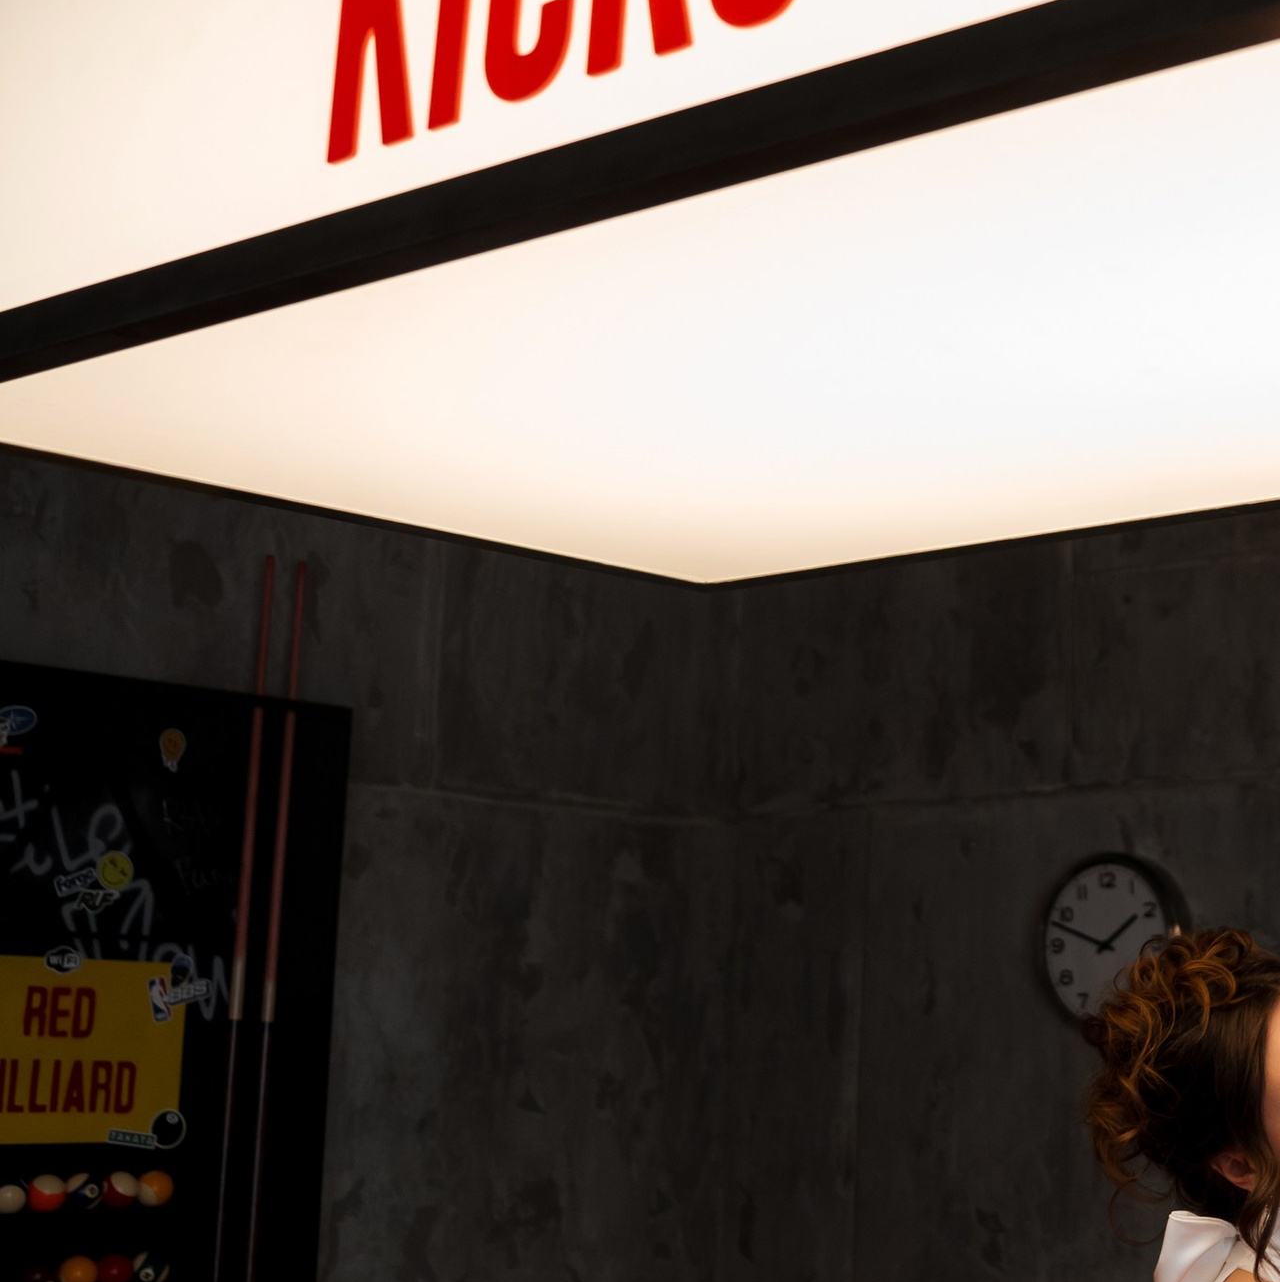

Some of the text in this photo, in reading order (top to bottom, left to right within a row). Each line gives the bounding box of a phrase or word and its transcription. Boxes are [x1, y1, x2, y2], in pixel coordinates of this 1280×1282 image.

[1100, 872, 1115, 888] 12
[1060, 907, 1073, 922] 10
[1144, 902, 1156, 918] 2
[1051, 938, 1064, 954] 9
[1060, 970, 1073, 985] 8
[1077, 993, 1088, 1008] 7
[23, 985, 97, 1039] RED
